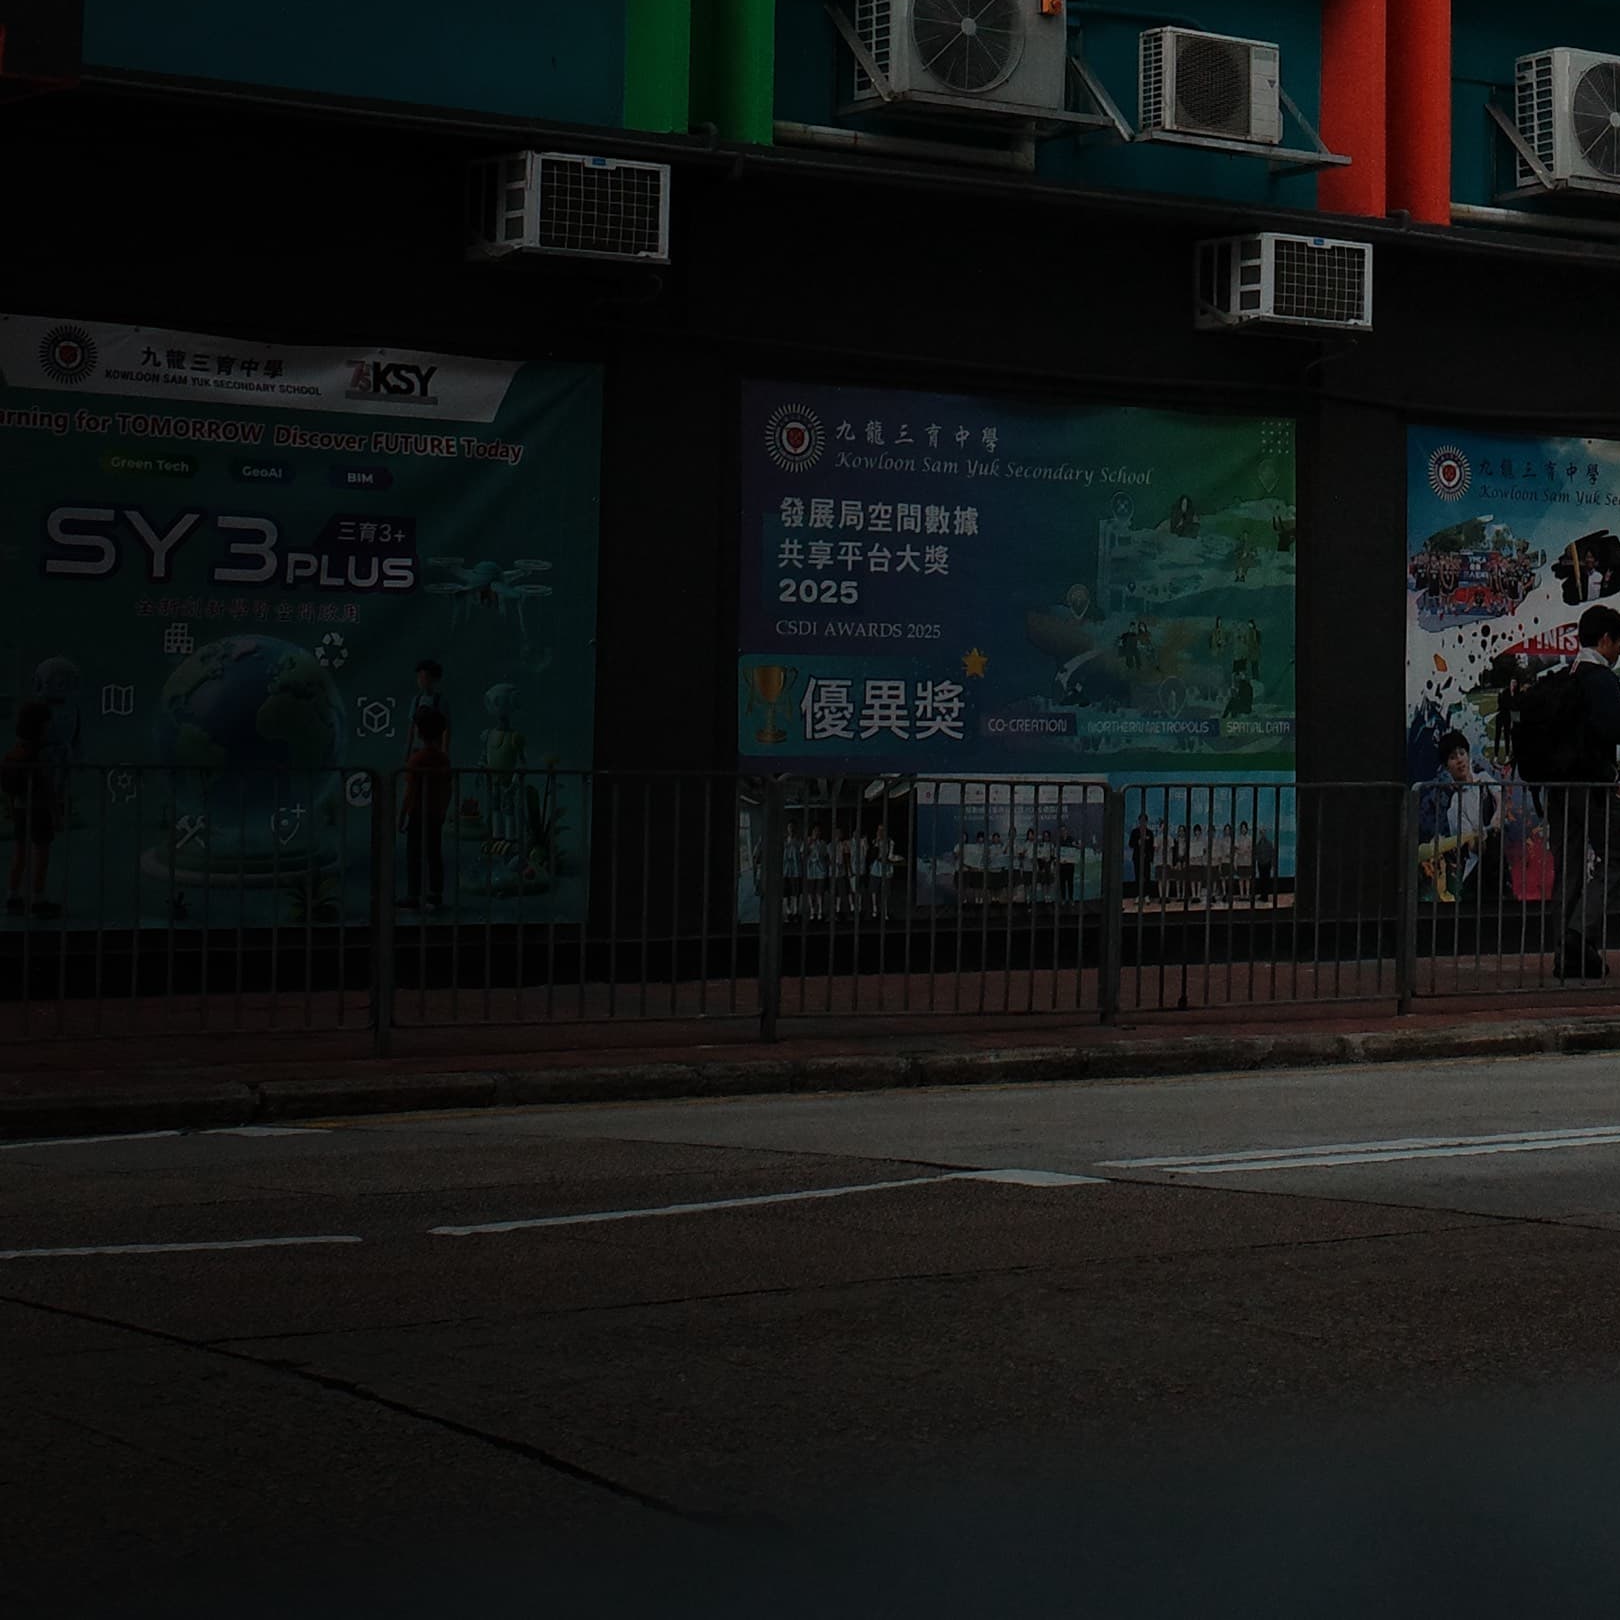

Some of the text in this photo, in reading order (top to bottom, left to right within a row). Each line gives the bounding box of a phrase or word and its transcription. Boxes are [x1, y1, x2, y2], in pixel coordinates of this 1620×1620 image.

[142, 346, 284, 379] 九龍三育中學
[105, 369, 322, 396] KOWLOON SAM YUK SECONDARY SCHOOL
[77, 409, 111, 433] for
[118, 413, 263, 444] TOMORROW
[275, 424, 367, 450] Discover
[371, 432, 457, 456] FUTURE
[461, 436, 523, 464] Today
[834, 419, 999, 453] 九龍三育中學
[111, 456, 190, 473] Green Tech
[242, 464, 283, 479] GeoAI
[834, 452, 1152, 487] Kowloon Sam Yuk Secondary School
[1478, 461, 1600, 486] 九龍三育中學
[347, 472, 375, 484] BIM
[1479, 484, 1538, 501] Kowloon
[1543, 489, 1571, 503] Sam
[1576, 490, 1600, 506] Yuk
[779, 496, 980, 536] 發展局空間數據
[336, 520, 406, 542] 三育3+
[45, 506, 415, 589] SY 3 PLUS
[778, 538, 949, 575] 共享平台大獎
[778, 578, 859, 604] 2025
[775, 619, 941, 639] CSDI AWARDS 2025
[800, 677, 966, 740] 優異獎
[987, 718, 1067, 733] CO-CREATION
[1265, 721, 1290, 733] DATA
